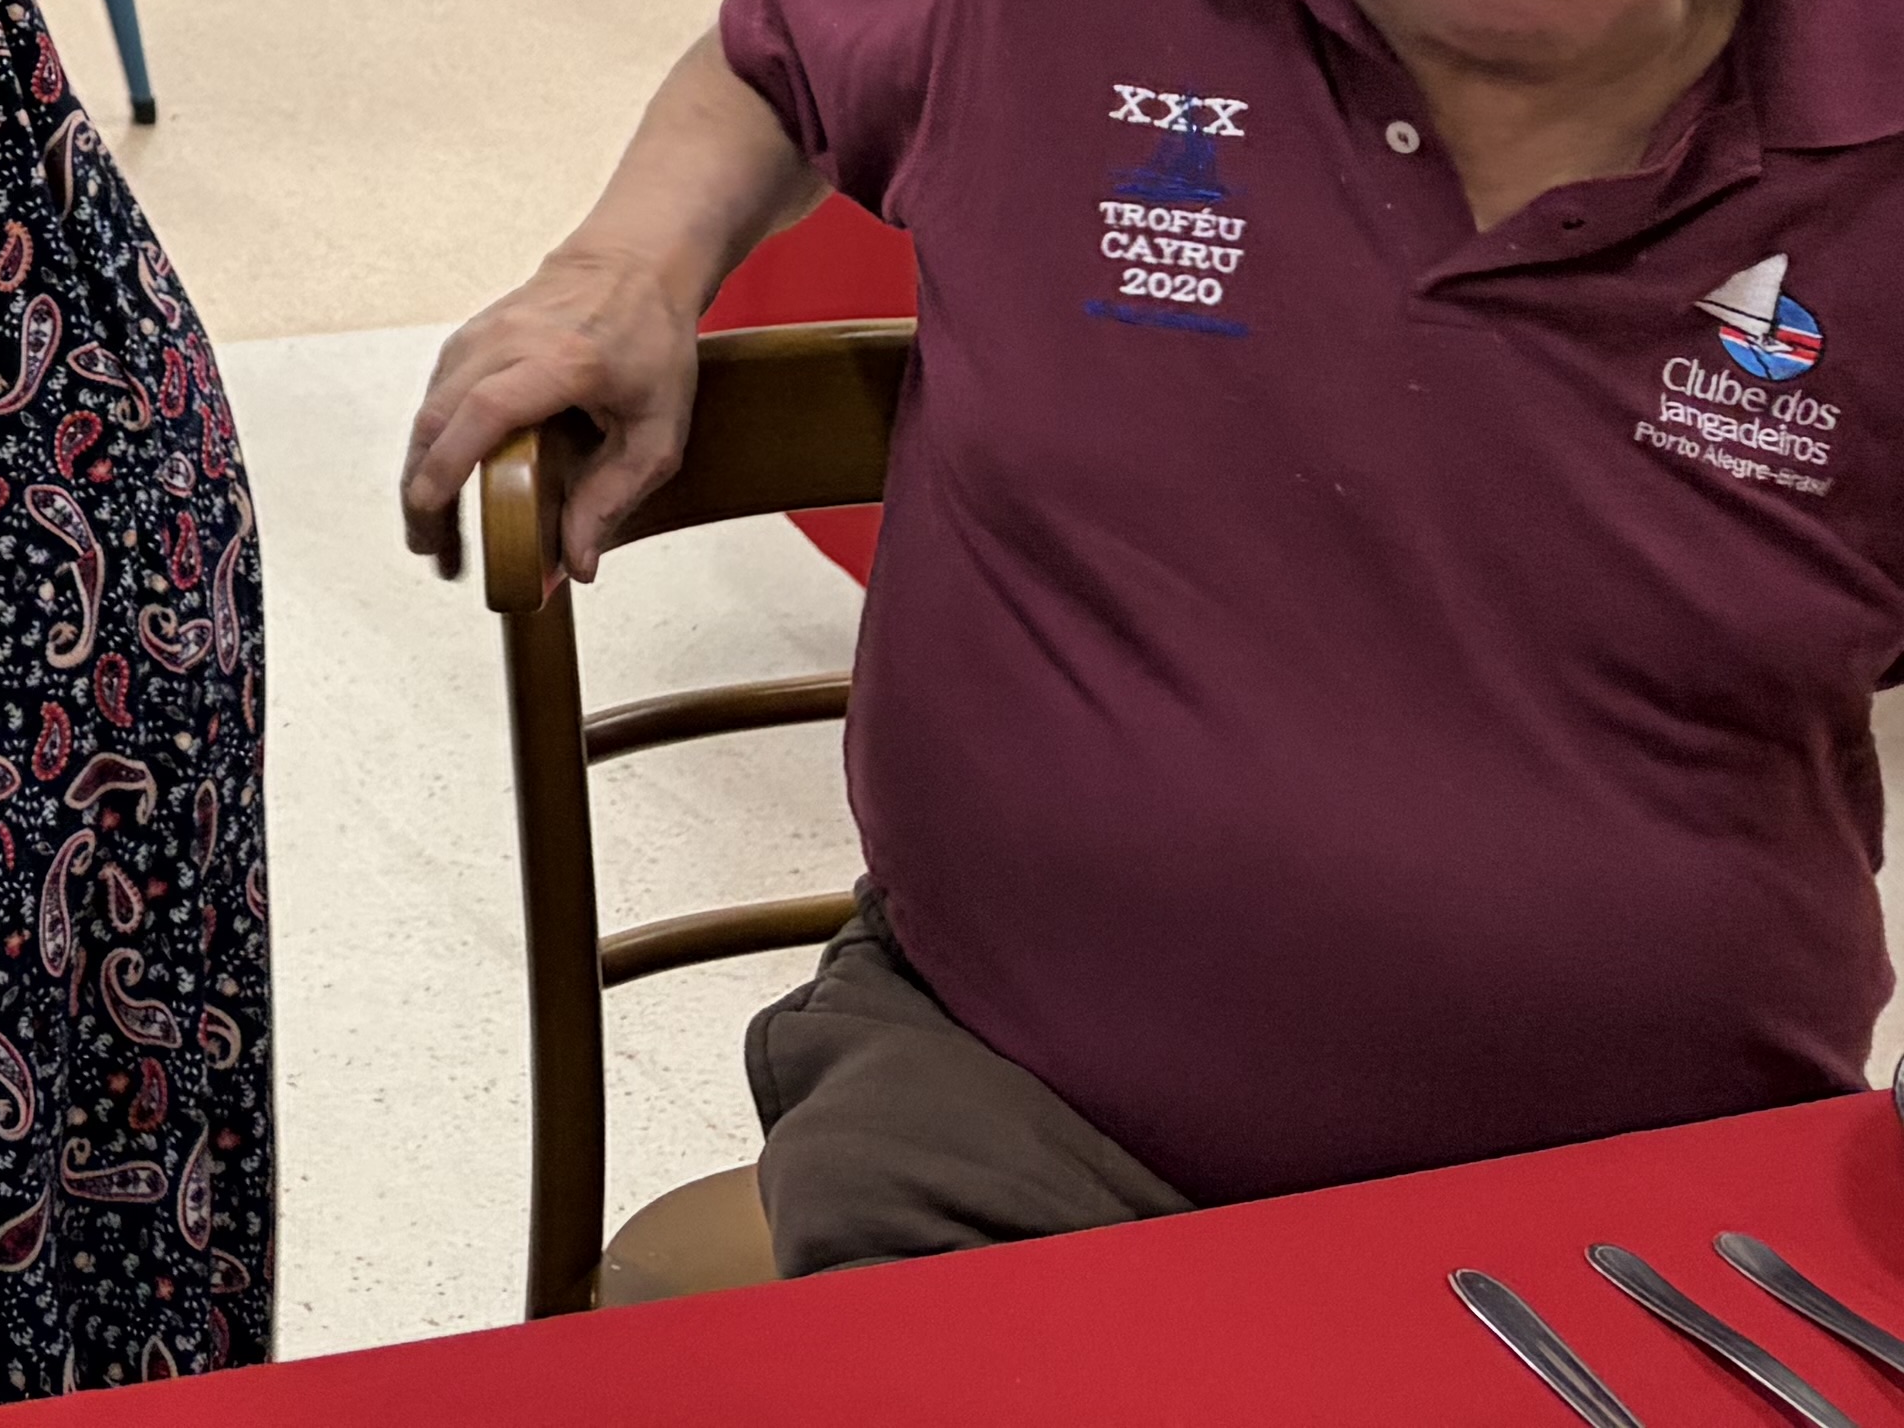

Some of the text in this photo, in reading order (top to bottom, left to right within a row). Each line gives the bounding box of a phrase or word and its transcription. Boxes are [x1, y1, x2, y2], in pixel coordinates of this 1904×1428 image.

[1109, 84, 1248, 136] XXX
[1099, 201, 1247, 241] TROFÉU
[1100, 231, 1244, 273] CAYRU
[1119, 268, 1223, 305] 2020
[1662, 357, 1841, 430] Clube dos
[1634, 421, 1700, 458] Porto
[1659, 392, 1831, 465] Jangadeiros
